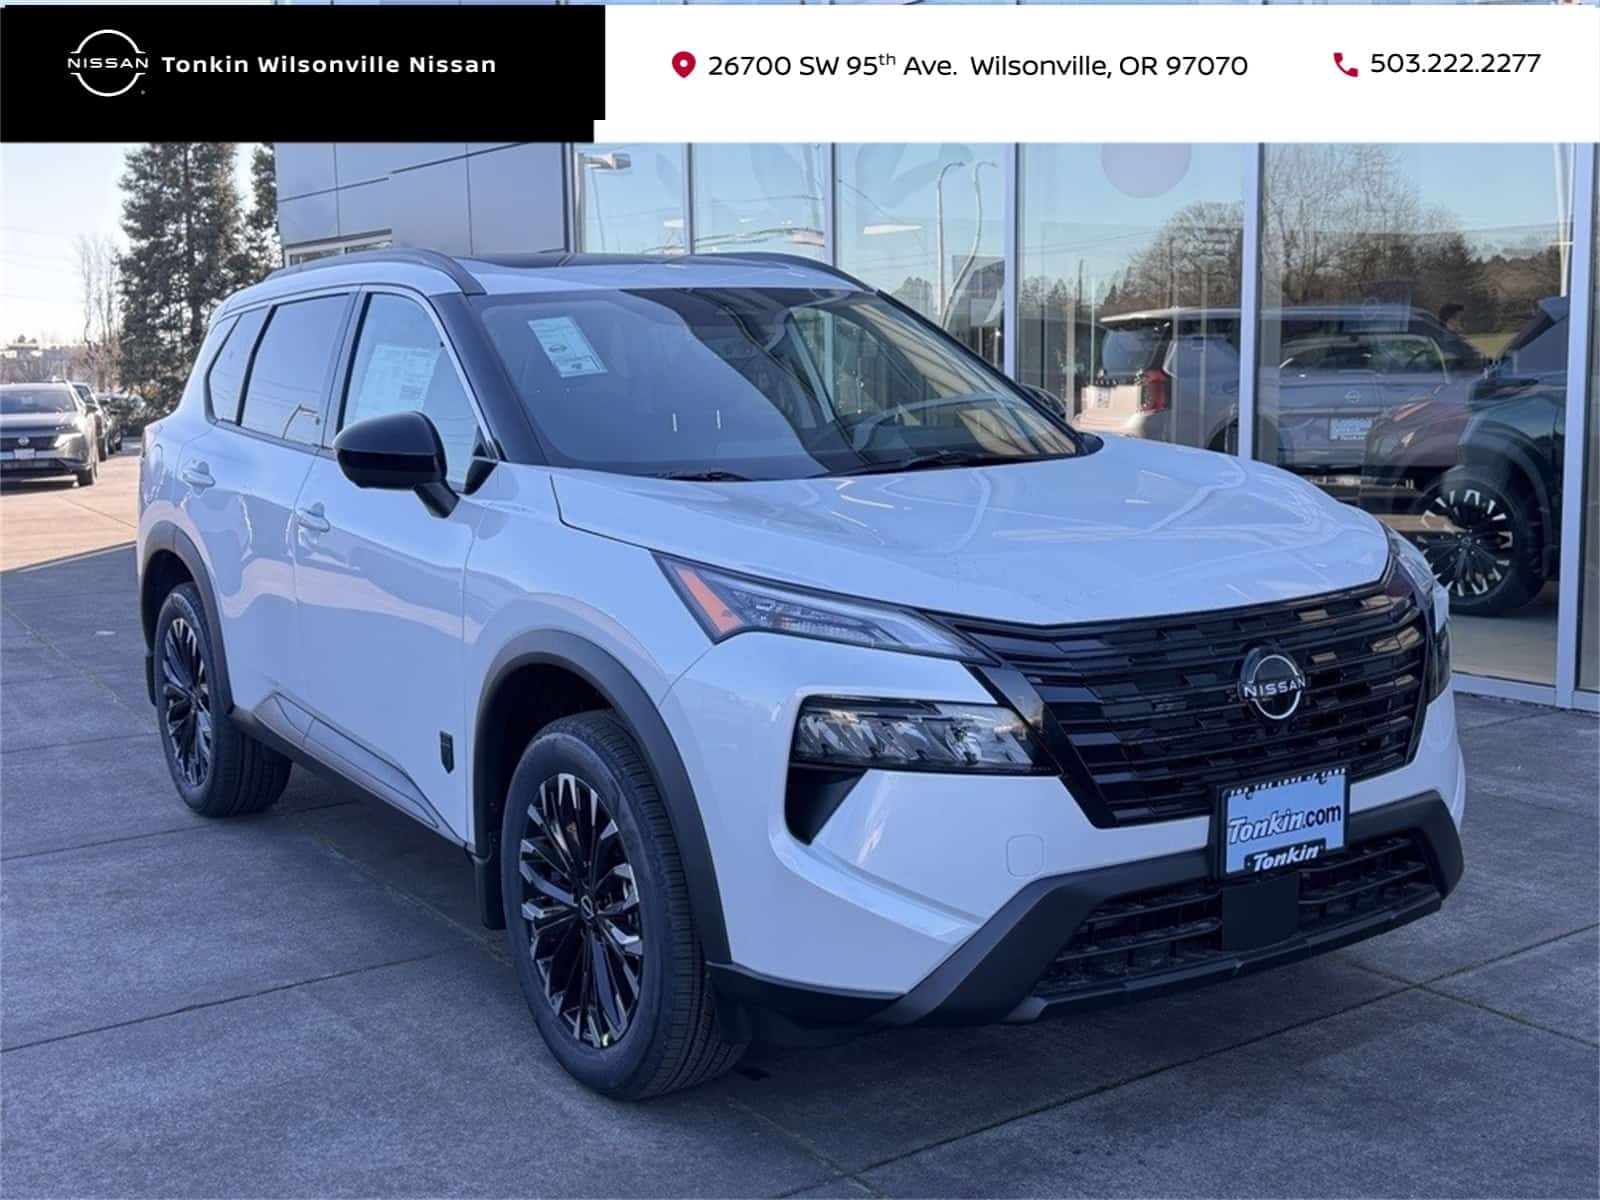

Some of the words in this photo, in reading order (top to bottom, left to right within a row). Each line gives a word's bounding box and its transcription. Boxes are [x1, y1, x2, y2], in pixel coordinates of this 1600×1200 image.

[1243, 678, 1306, 698] NISSAN
[1228, 804, 1341, 846] Tonkin.com
[1252, 844, 1320, 872] Tonkin
